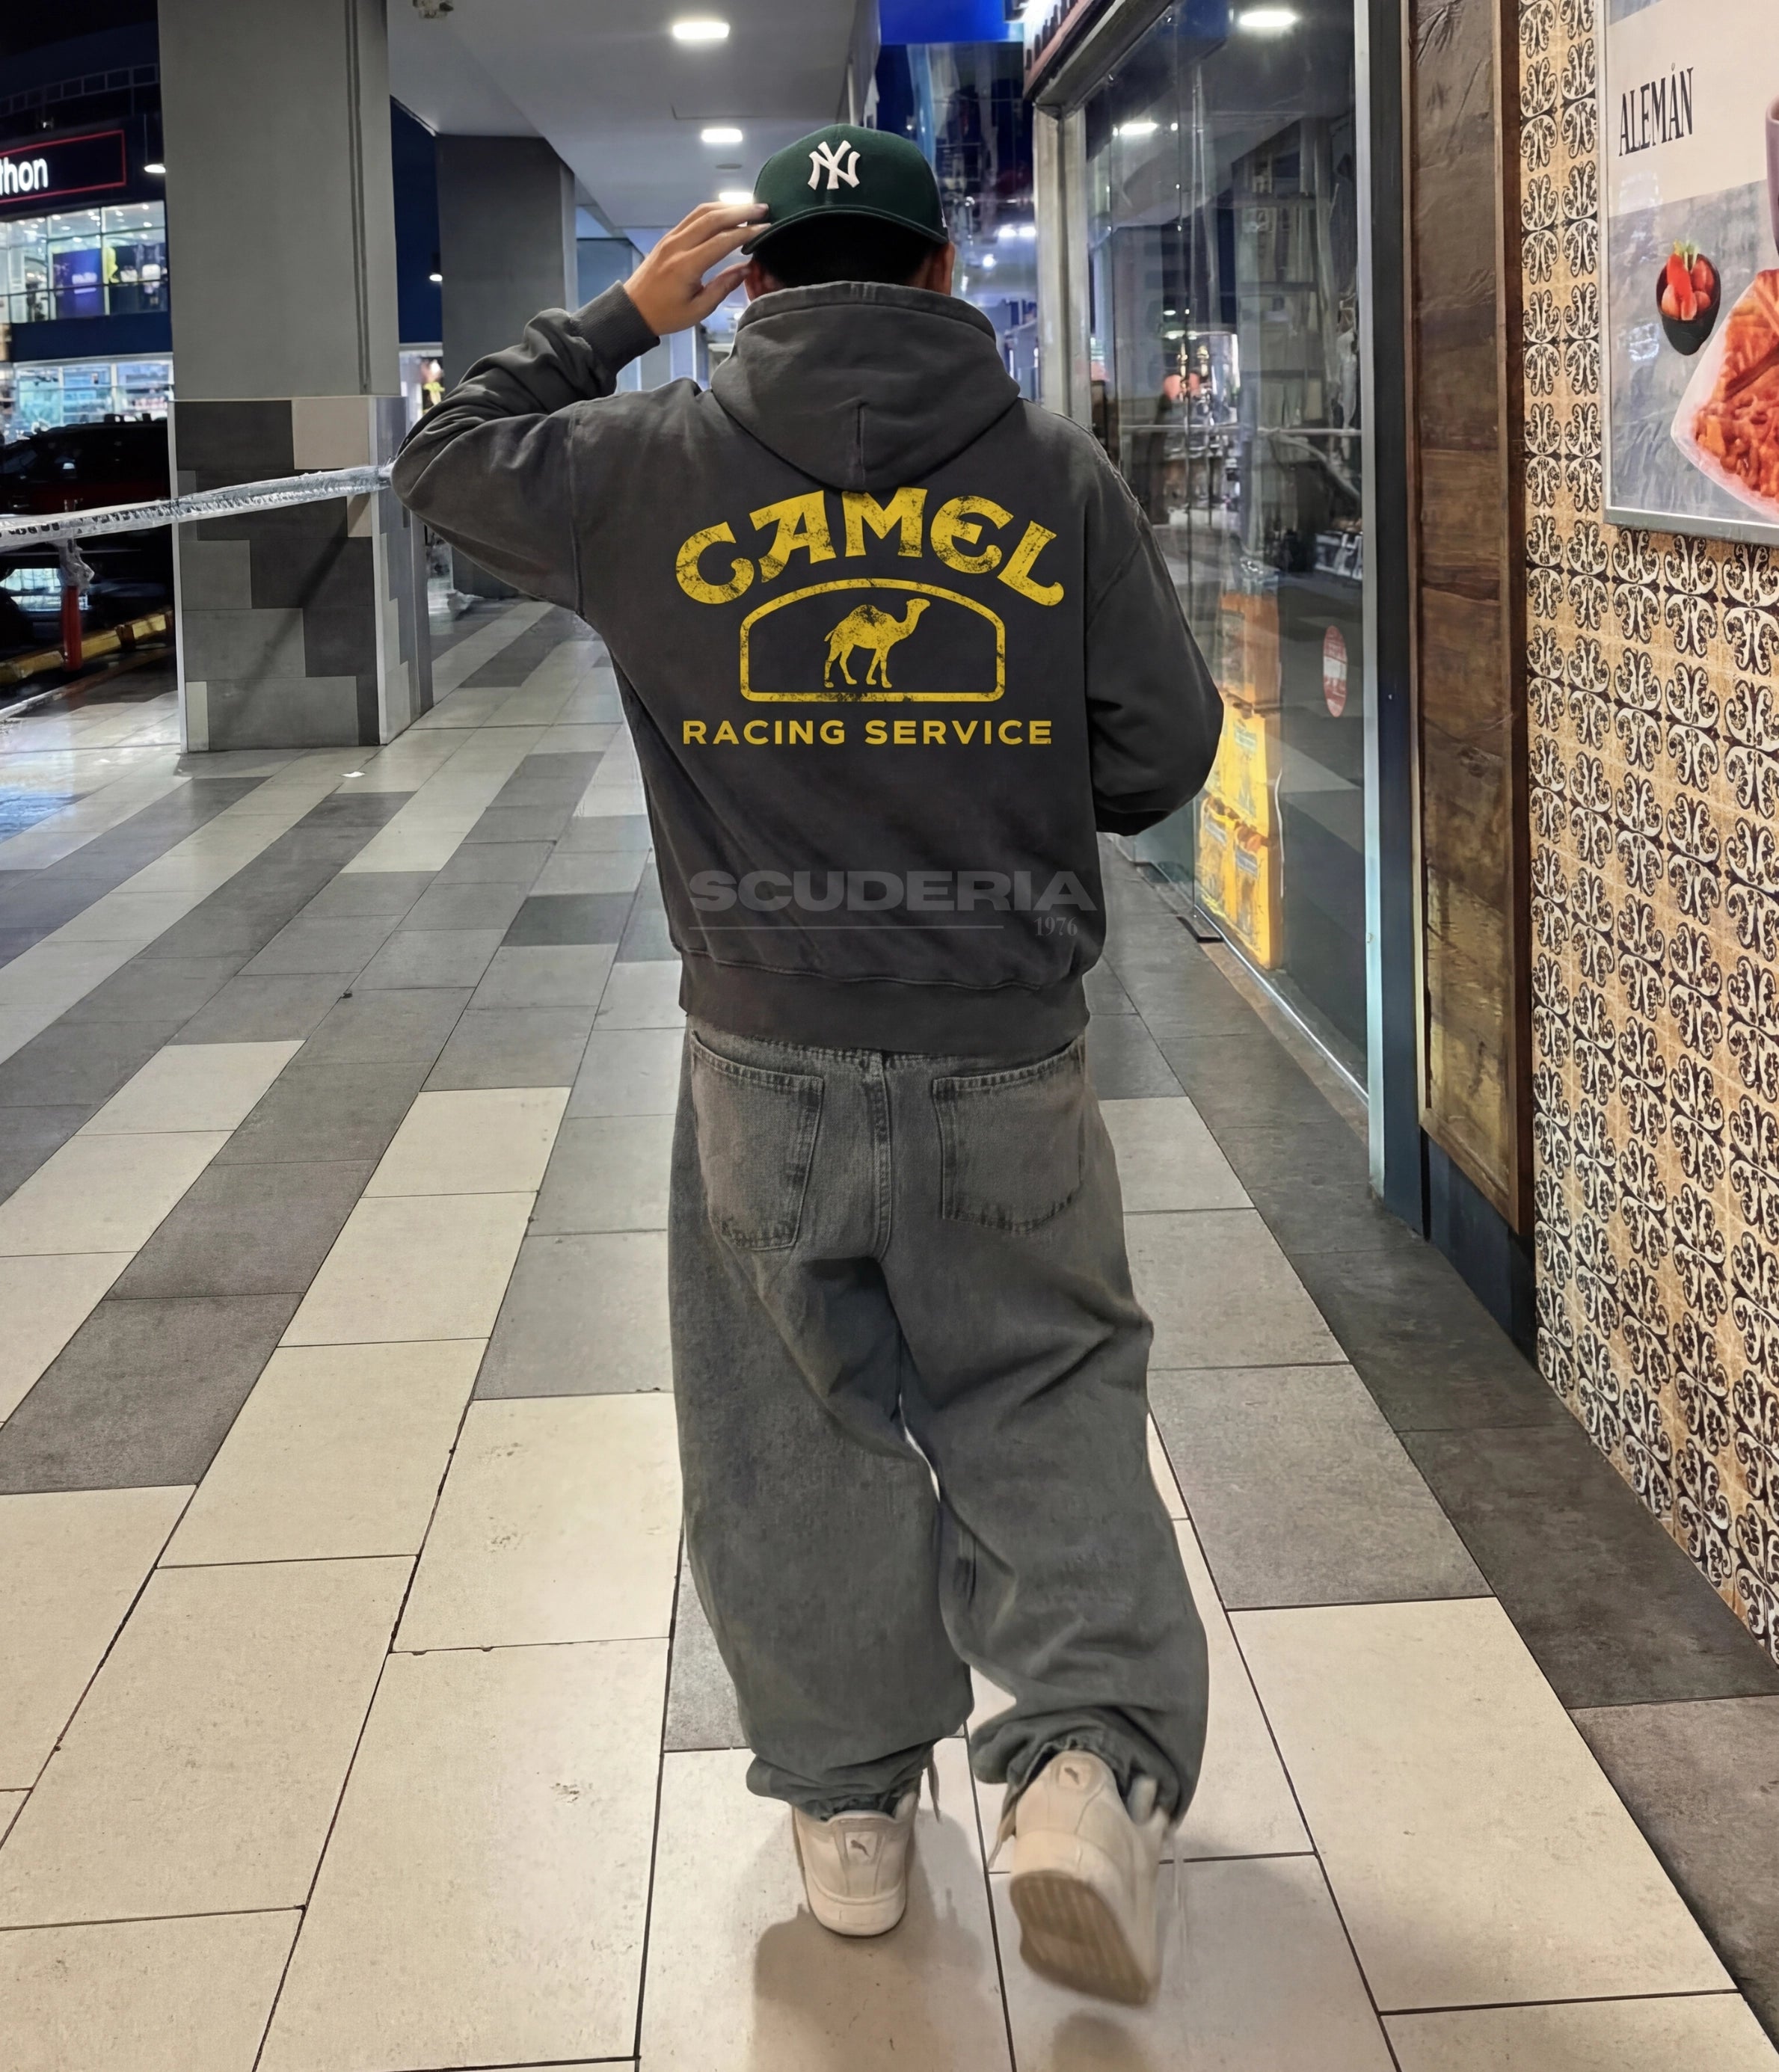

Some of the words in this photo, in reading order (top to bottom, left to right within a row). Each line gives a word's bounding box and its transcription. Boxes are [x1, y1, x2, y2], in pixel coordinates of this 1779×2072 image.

[1619, 62, 1694, 156] ALEMÁN
[808, 140, 861, 190] NY
[675, 487, 1065, 606] CAMEL
[683, 719, 846, 745] RACING
[865, 719, 1053, 745] SERVICE
